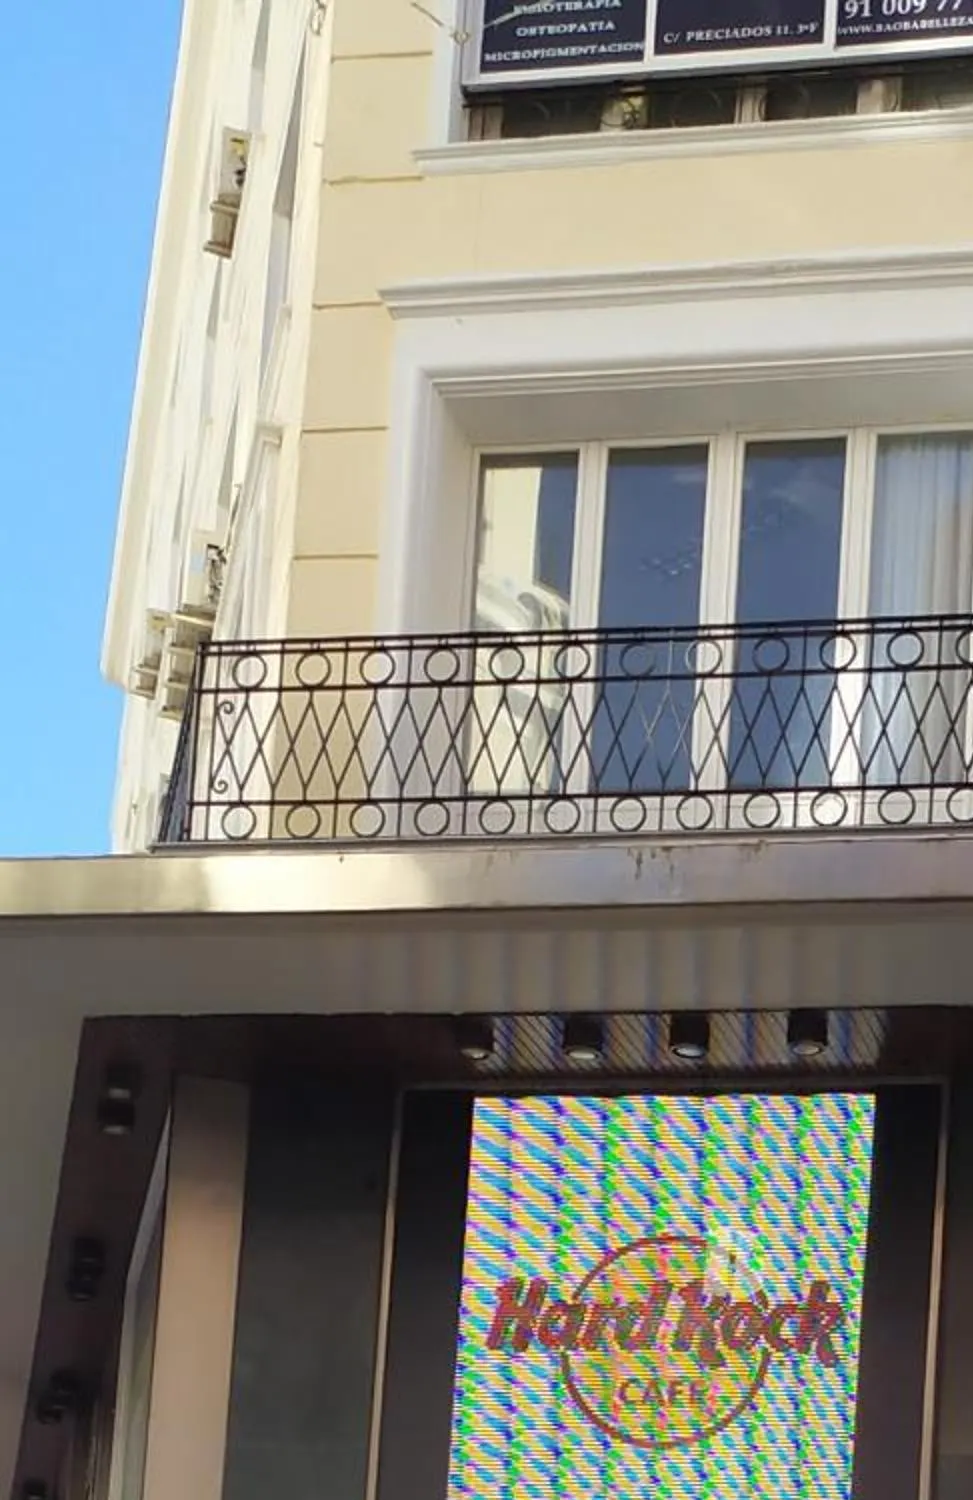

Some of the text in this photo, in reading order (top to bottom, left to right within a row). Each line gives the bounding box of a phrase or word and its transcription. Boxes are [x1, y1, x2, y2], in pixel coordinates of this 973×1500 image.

[844, 0, 873, 19] 91
[882, 0, 928, 15] 009
[663, 32, 681, 43] C/
[685, 25, 772, 42] PRECIADOS
[486, 1276, 847, 1368] Hard Rock
